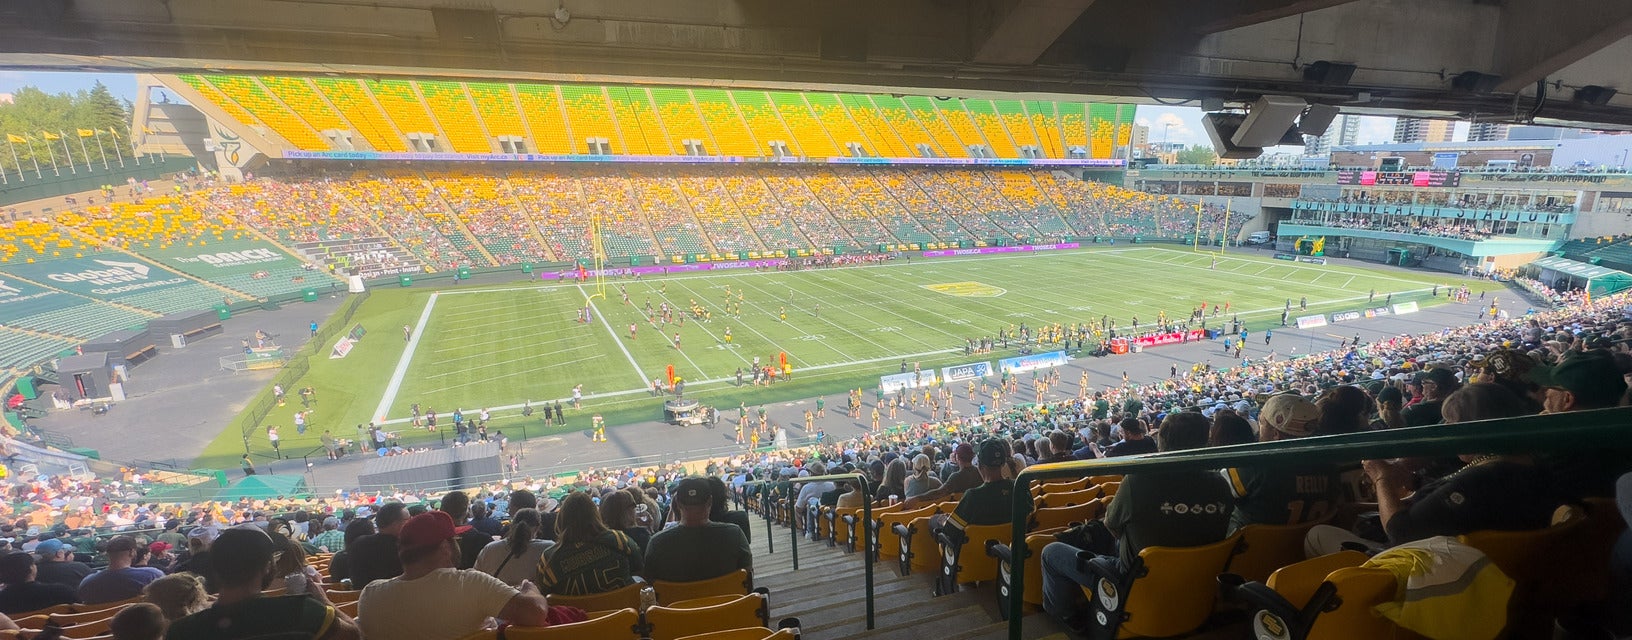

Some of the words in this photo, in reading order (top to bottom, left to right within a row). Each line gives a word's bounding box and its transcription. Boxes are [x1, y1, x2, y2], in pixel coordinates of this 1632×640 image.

[1456, 210, 1559, 224] STADIUM
[197, 247, 283, 265] BRICK
[47, 266, 134, 283] Global
[384, 267, 400, 276] Print
[952, 367, 976, 378] JAPA
